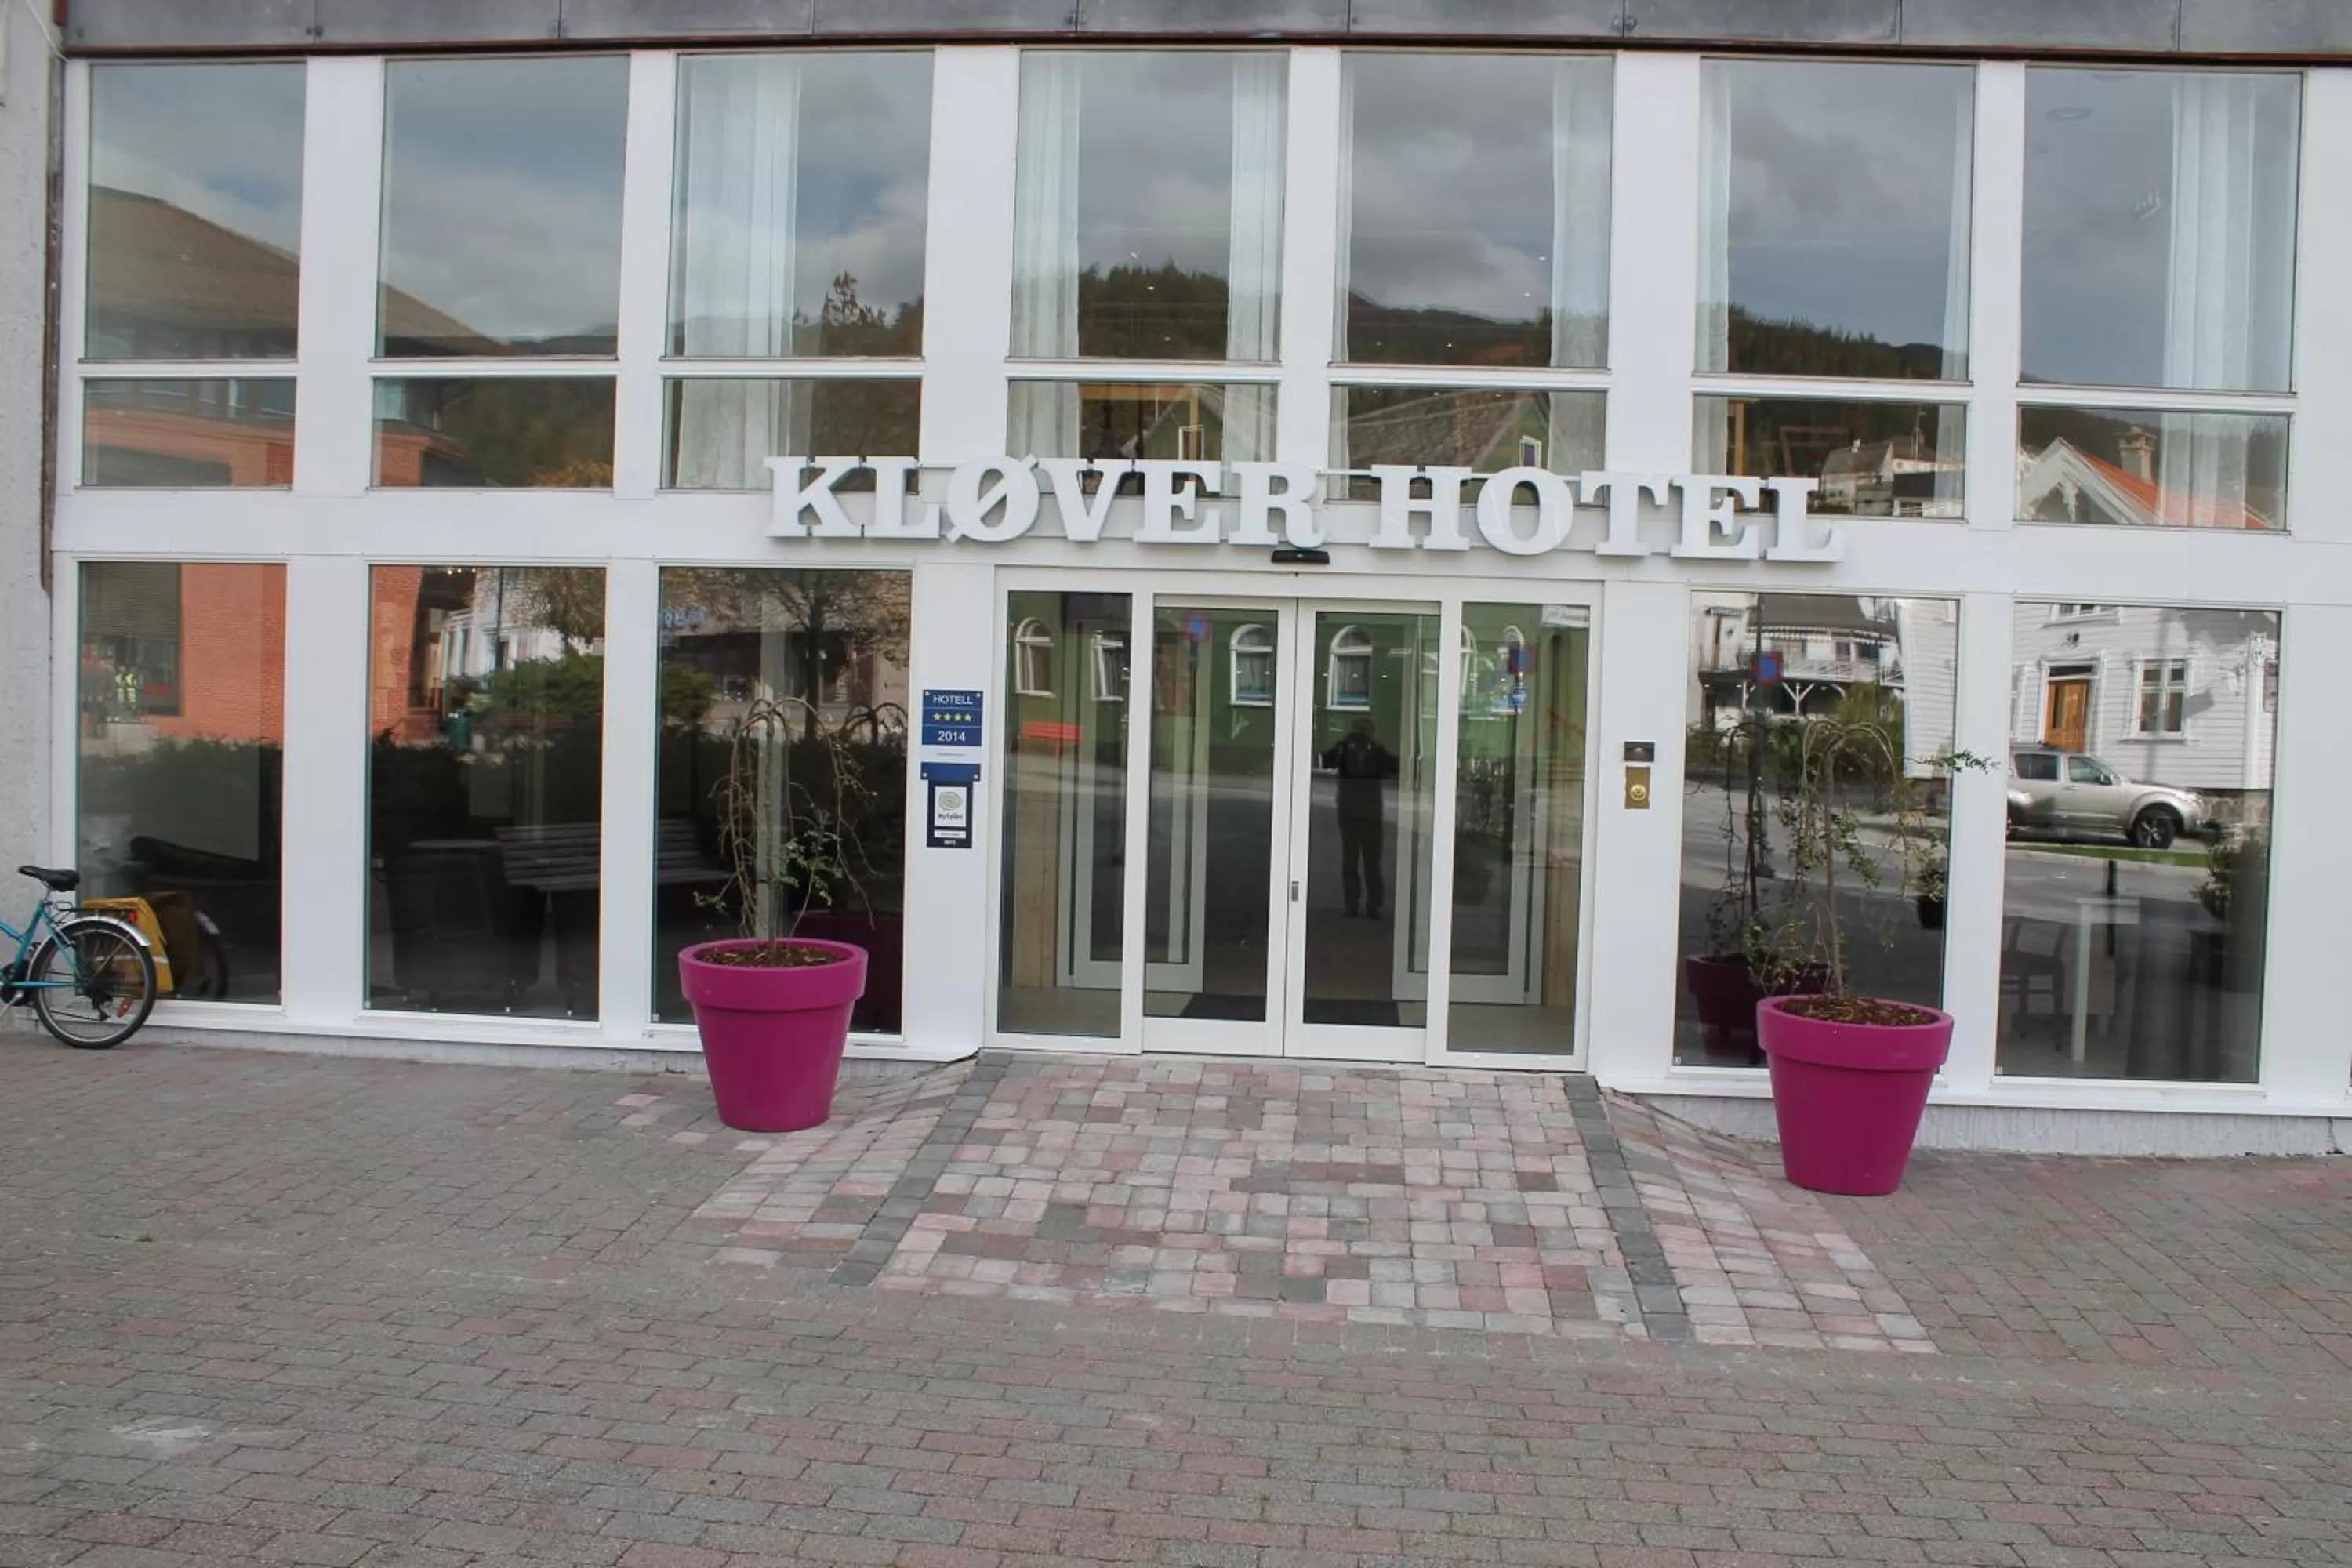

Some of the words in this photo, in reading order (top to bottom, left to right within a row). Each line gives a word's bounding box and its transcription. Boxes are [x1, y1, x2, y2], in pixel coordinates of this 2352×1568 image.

[764, 453, 1332, 548] KLØVER
[1368, 464, 1845, 562] HOTEL
[933, 695, 974, 705] HOTELL
[937, 731, 967, 742] 2014
